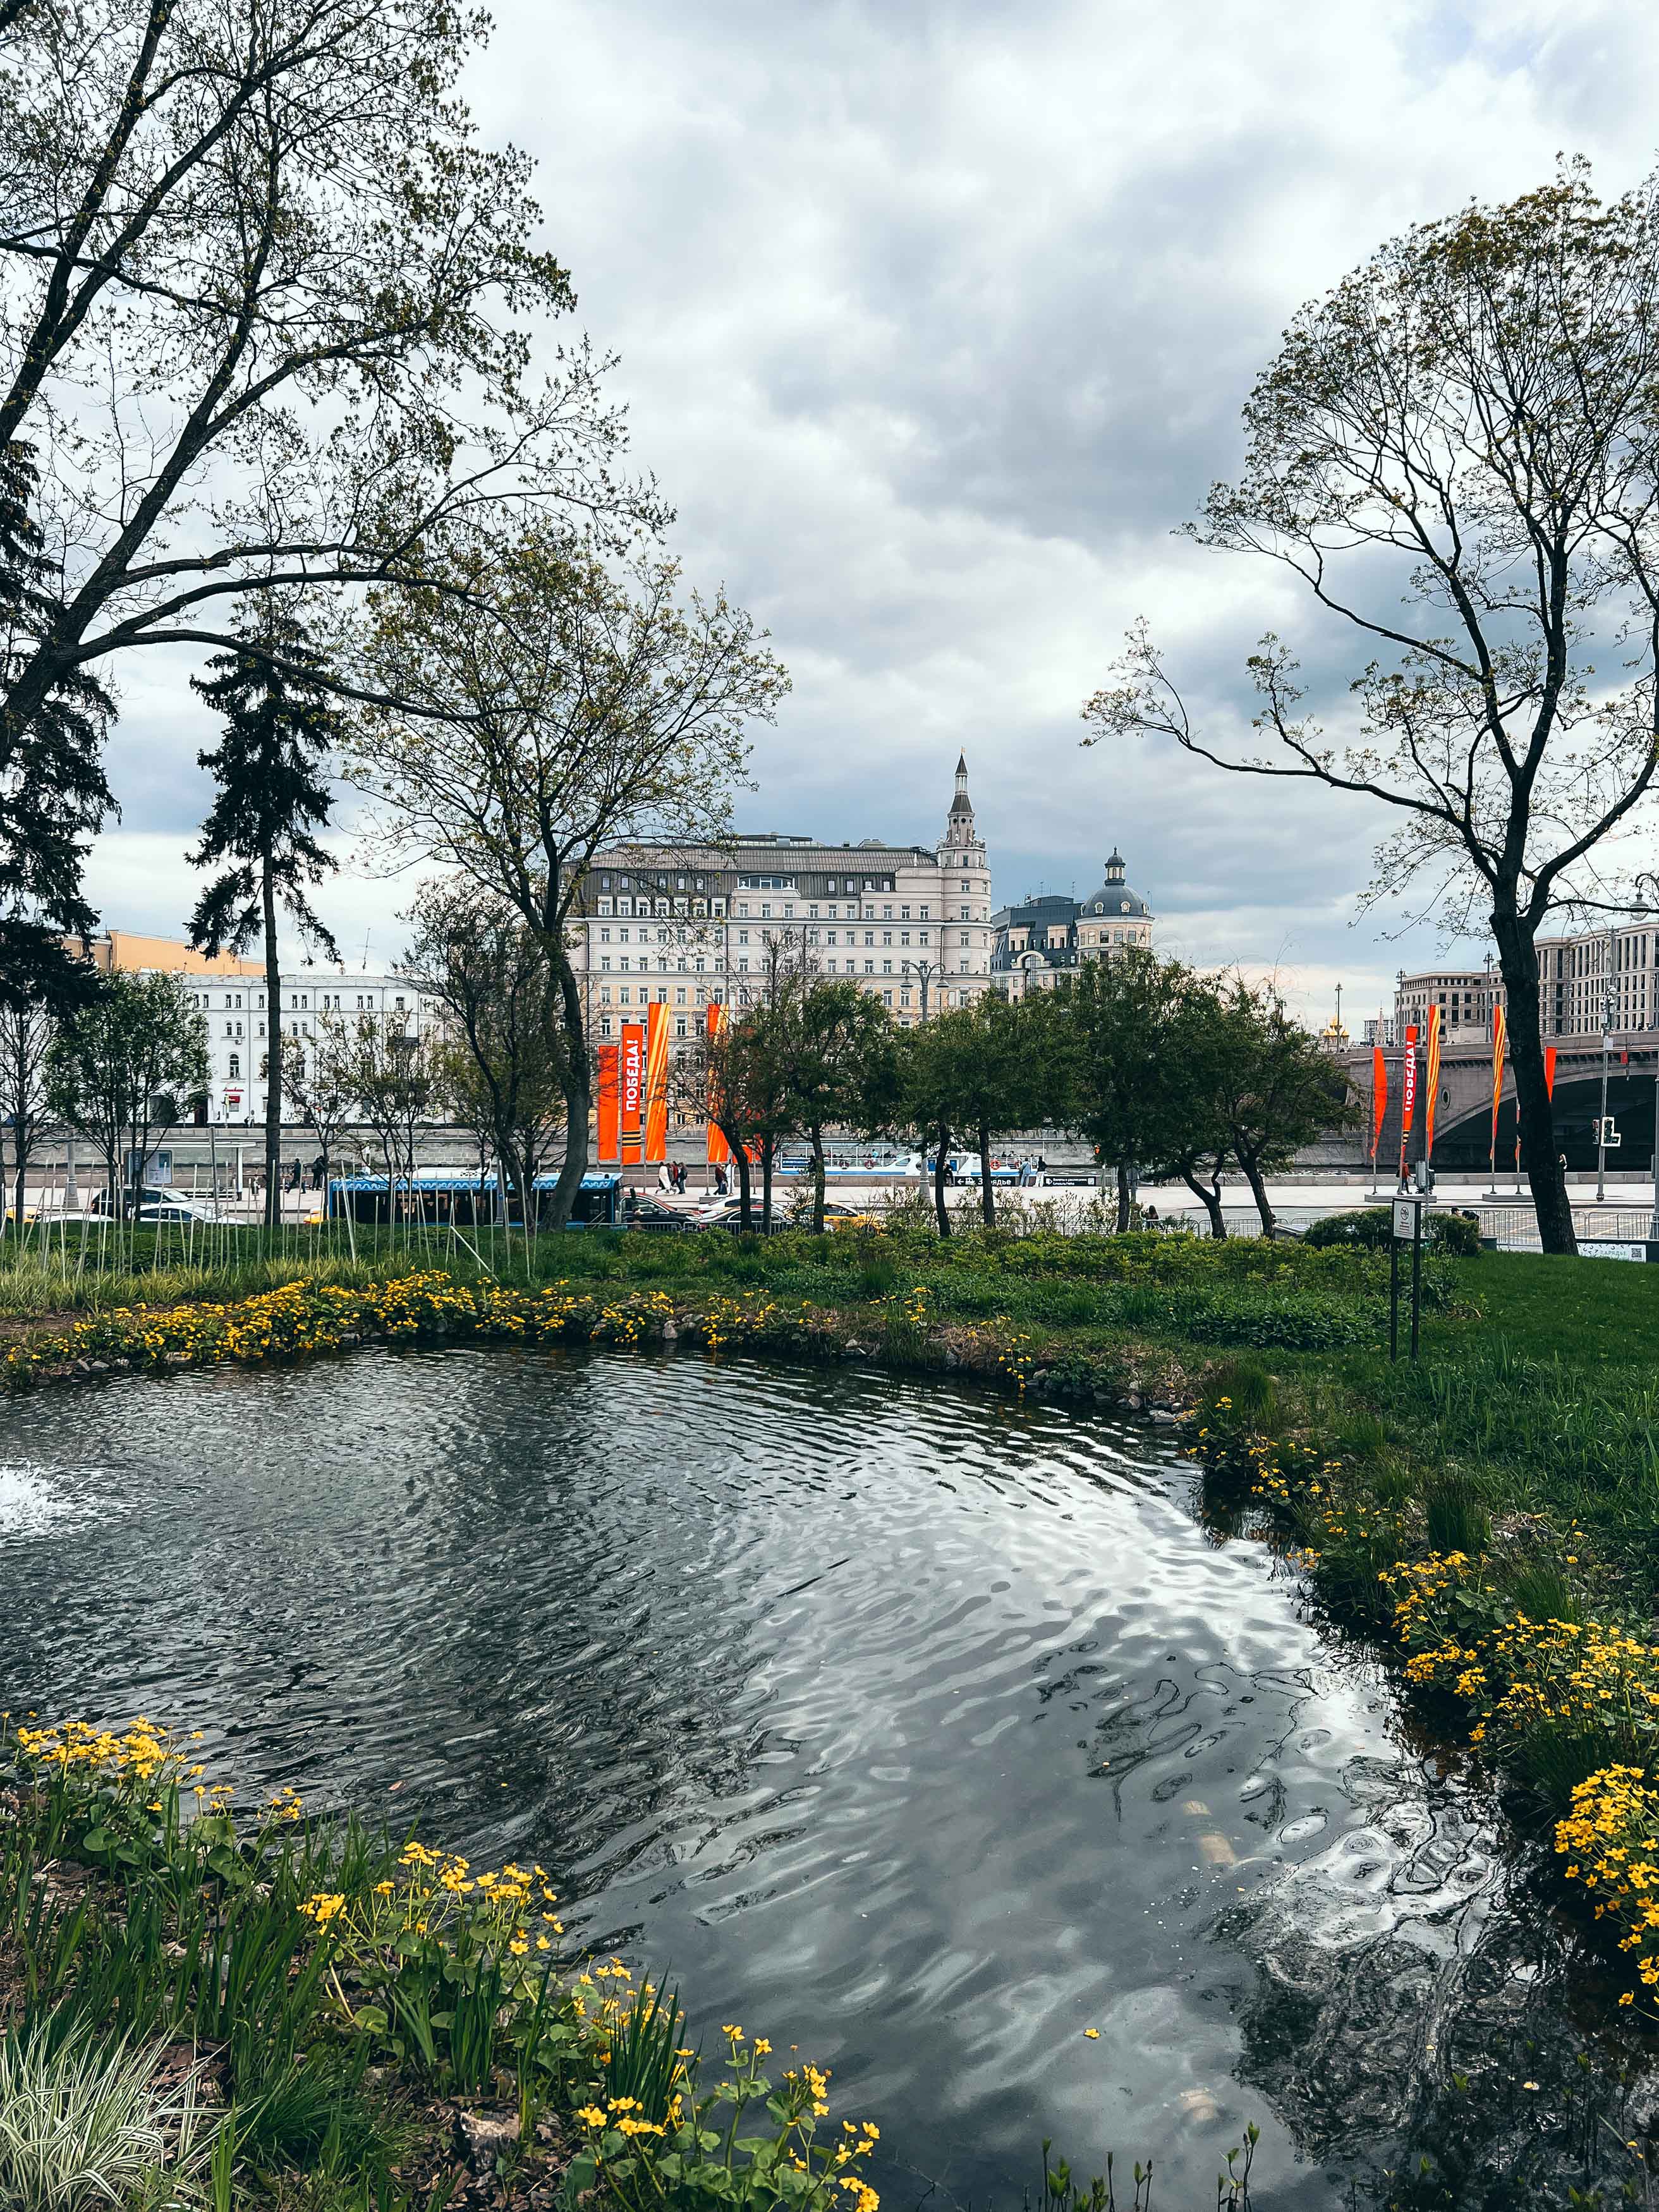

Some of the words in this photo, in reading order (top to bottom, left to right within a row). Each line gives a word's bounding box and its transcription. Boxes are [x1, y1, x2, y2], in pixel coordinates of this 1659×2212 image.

[626, 1040, 640, 1111] ПОБЕДА!
[1404, 1042, 1416, 1111] ПОБЕДА!
[978, 1177, 1012, 1186] Зядье
